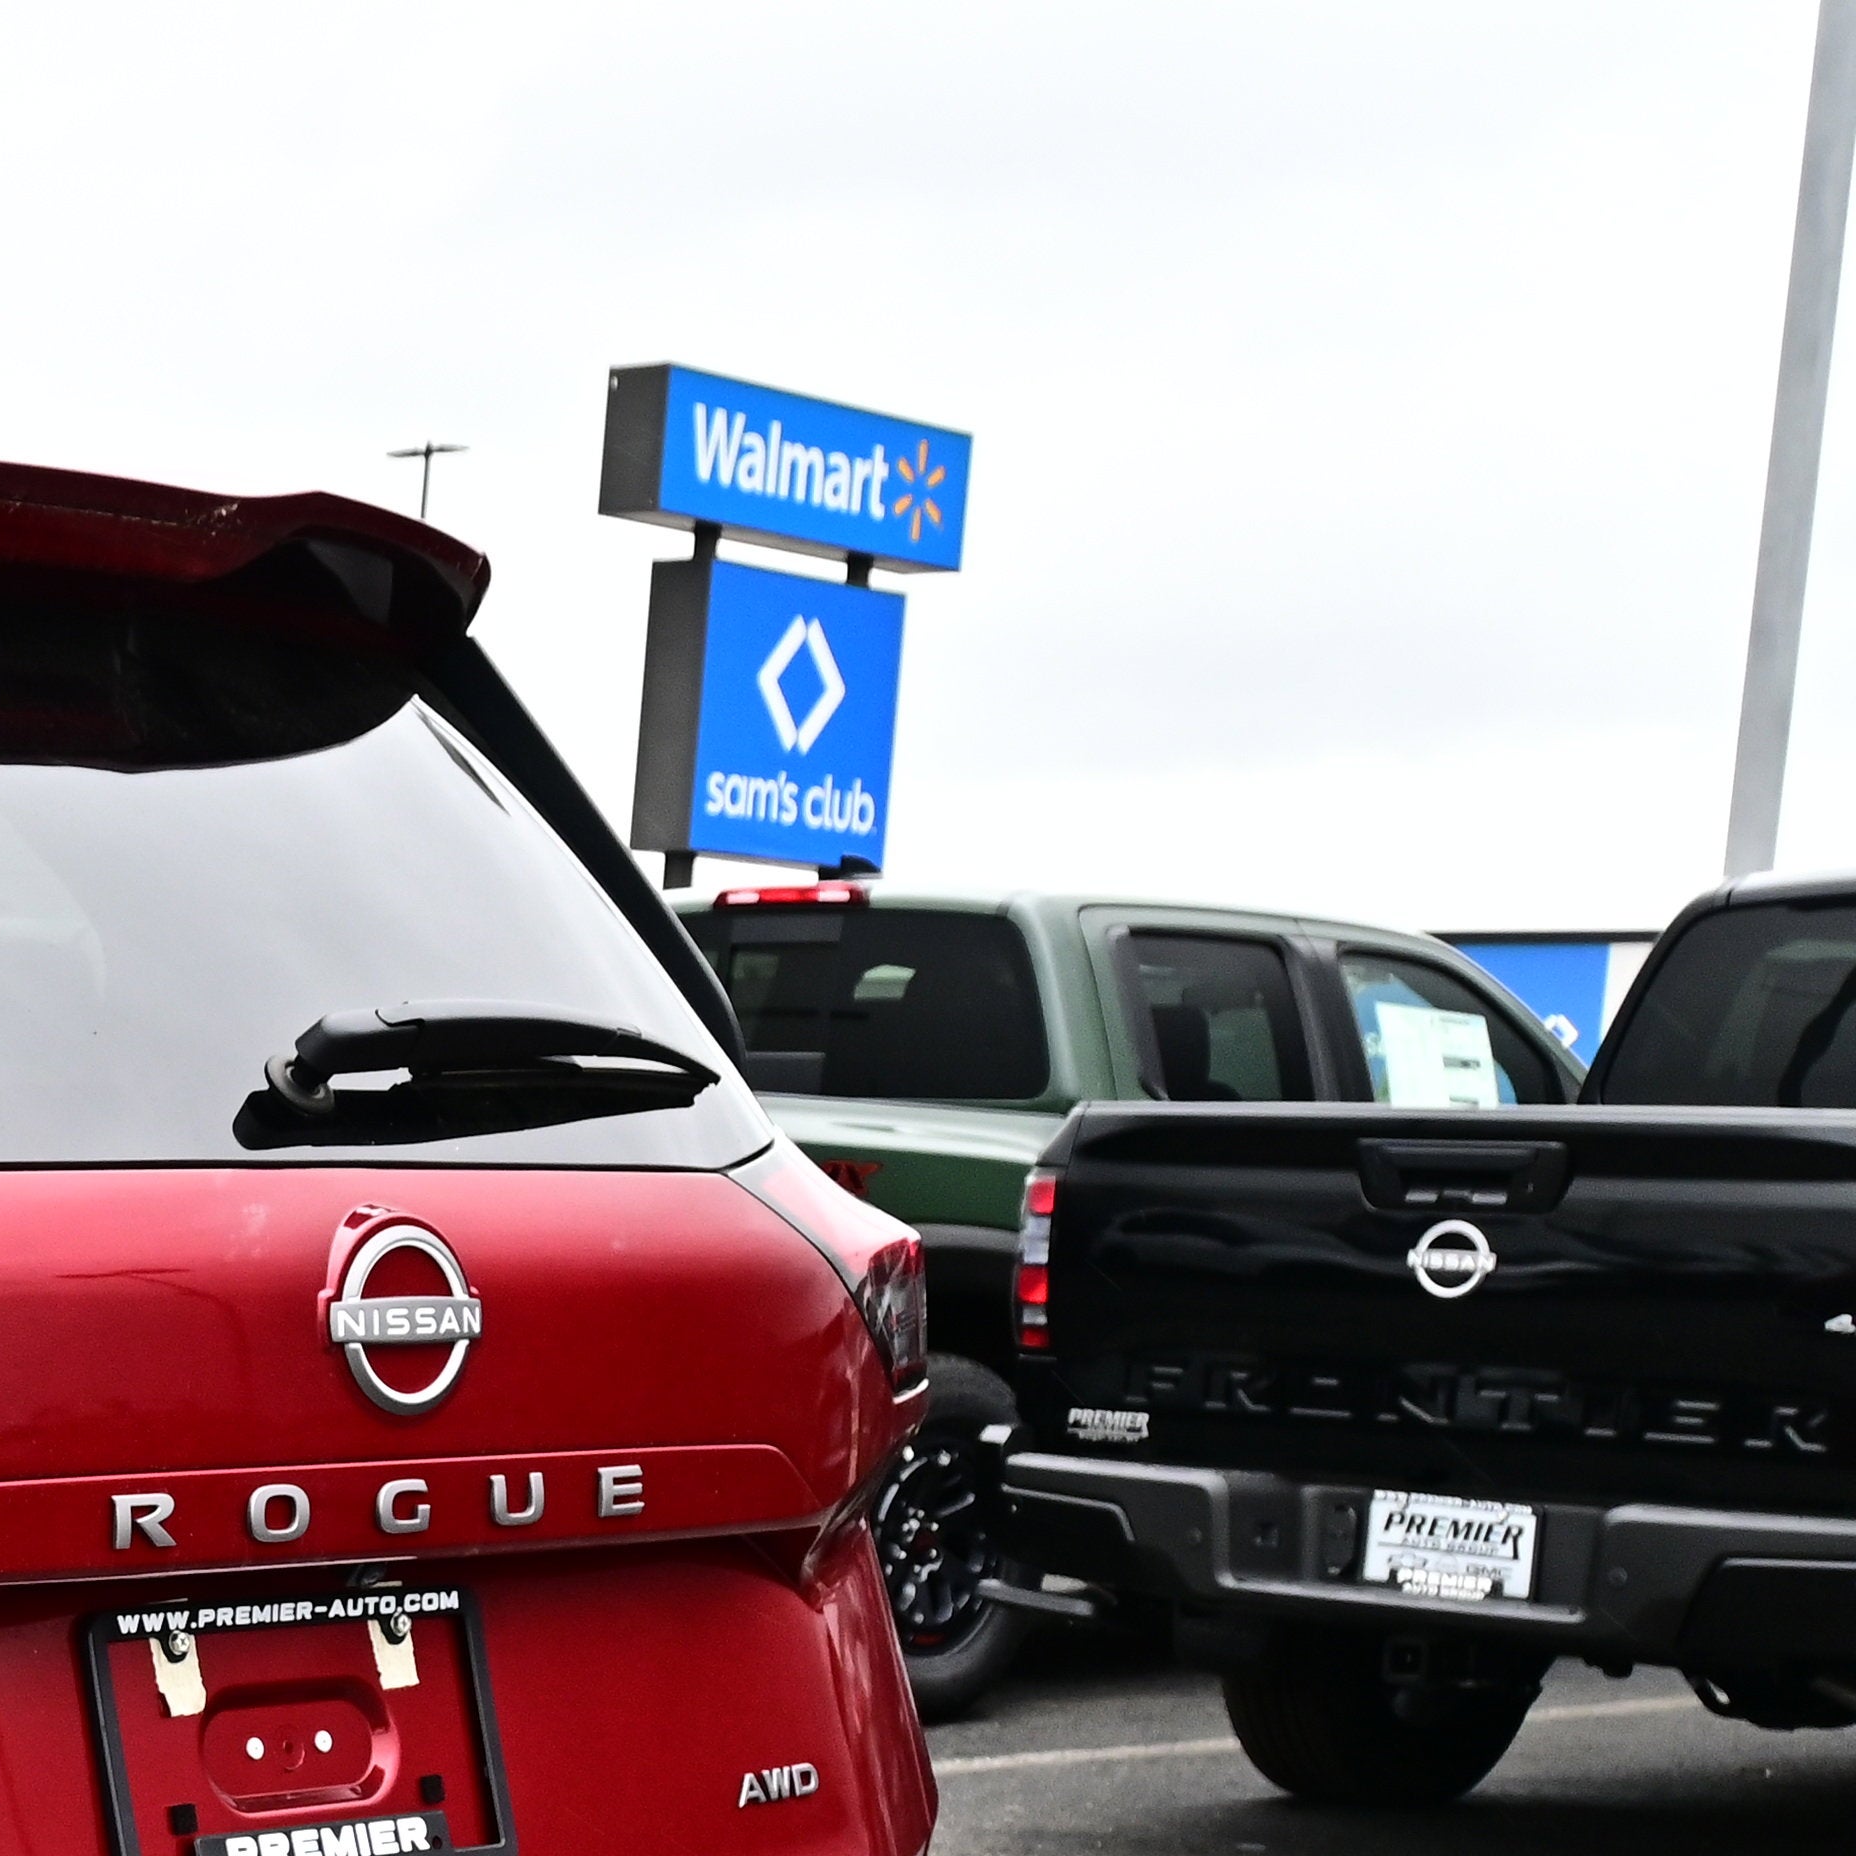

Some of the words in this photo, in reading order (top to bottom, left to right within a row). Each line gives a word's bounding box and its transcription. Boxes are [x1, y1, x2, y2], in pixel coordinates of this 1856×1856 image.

[693, 401, 889, 520] Walmart
[706, 769, 798, 827] sam's
[802, 772, 876, 836] club
[338, 1306, 481, 1338] NISSAN
[111, 1464, 645, 1550] ROGUE
[1384, 1511, 1523, 1557] PREMIER
[117, 1590, 460, 1634] WWW.PREMIER-AUTO.COM
[738, 1761, 820, 1808] AWD
